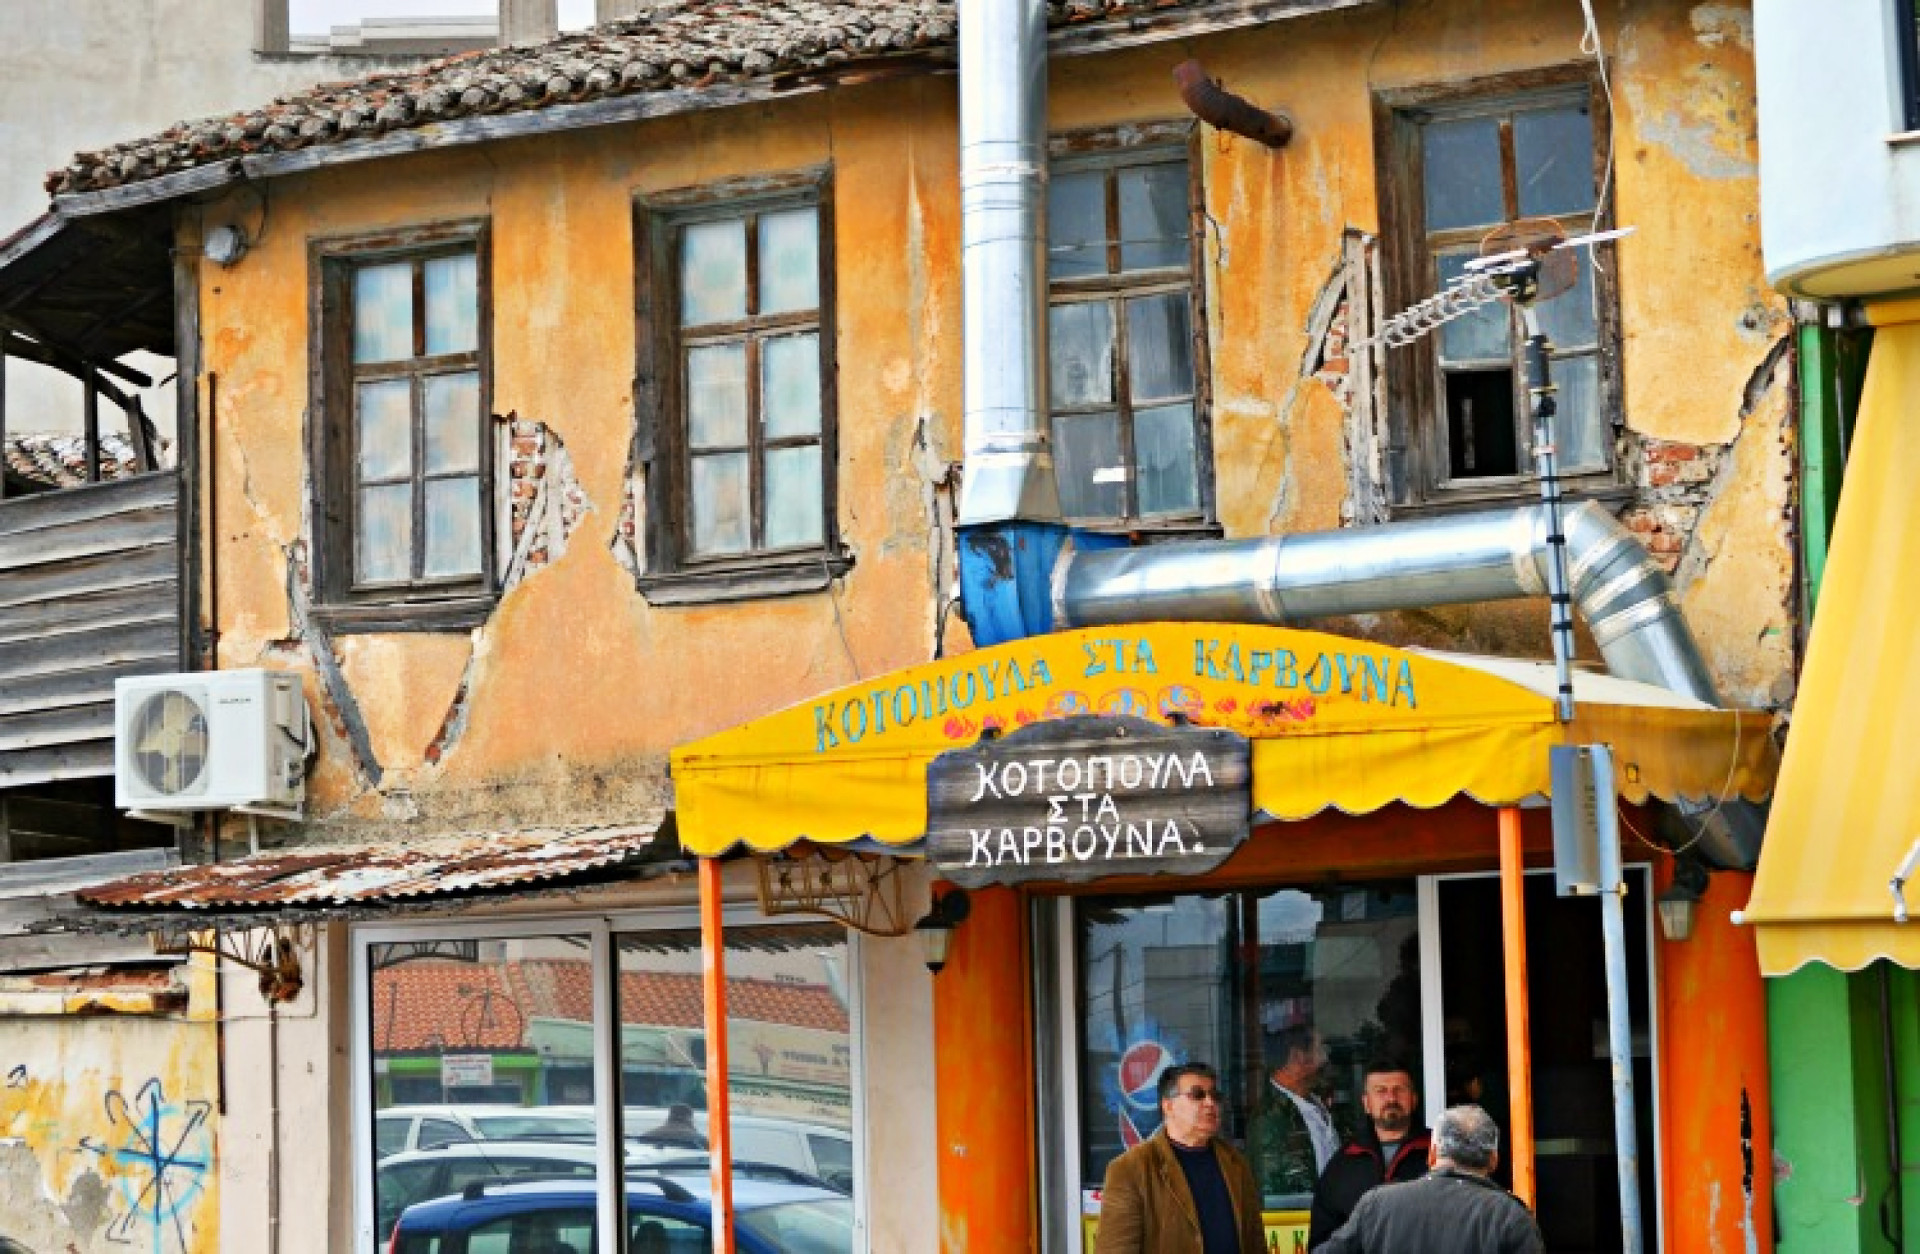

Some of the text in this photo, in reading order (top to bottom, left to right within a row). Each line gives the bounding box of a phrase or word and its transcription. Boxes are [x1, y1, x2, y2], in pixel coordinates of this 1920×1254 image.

[1082, 638, 1158, 678] ΣΤΑ
[970, 751, 1214, 801] ΚΟΤΟΠΟΥΛΑ
[1047, 793, 1120, 823] ΣΤΑ
